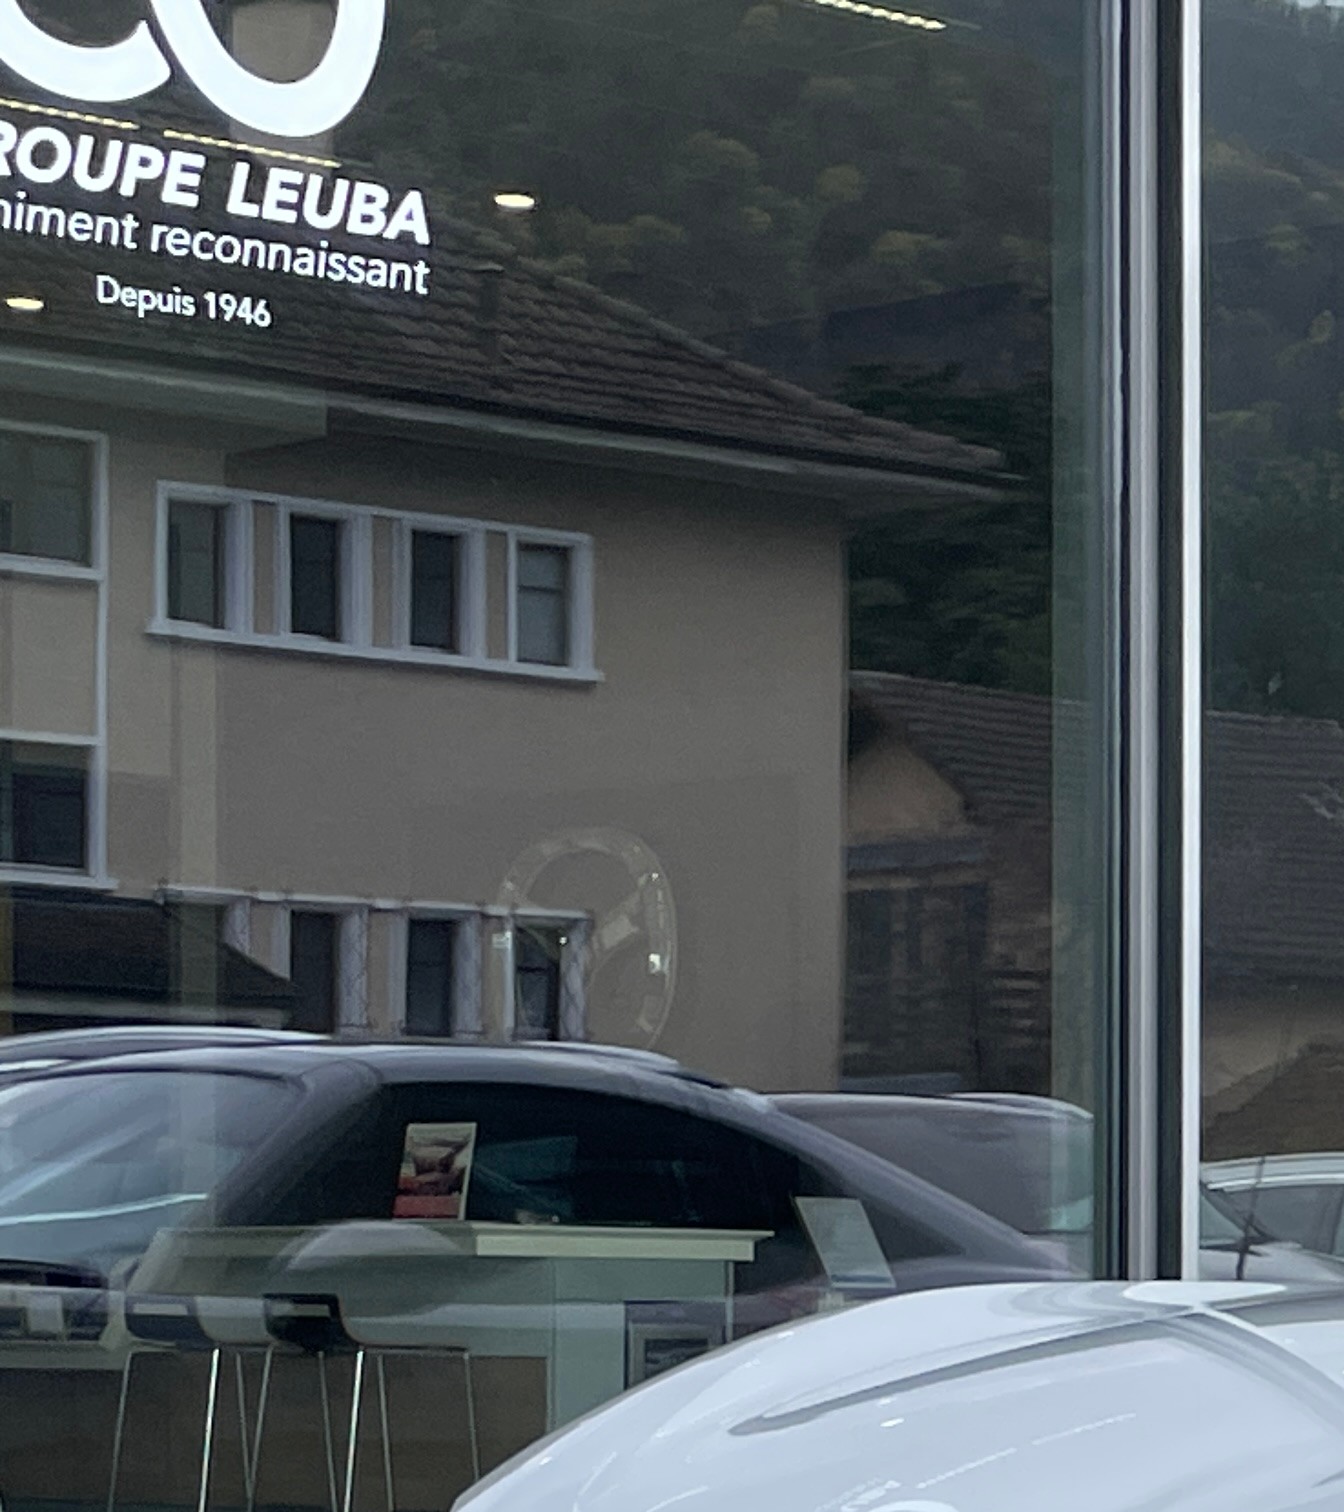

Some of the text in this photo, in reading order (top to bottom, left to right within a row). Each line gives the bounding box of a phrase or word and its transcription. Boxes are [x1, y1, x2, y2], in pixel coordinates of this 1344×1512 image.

[226, 161, 430, 246] LEUBA
[151, 223, 431, 296] reconnaissant
[96, 274, 272, 327] Depuis 1946
